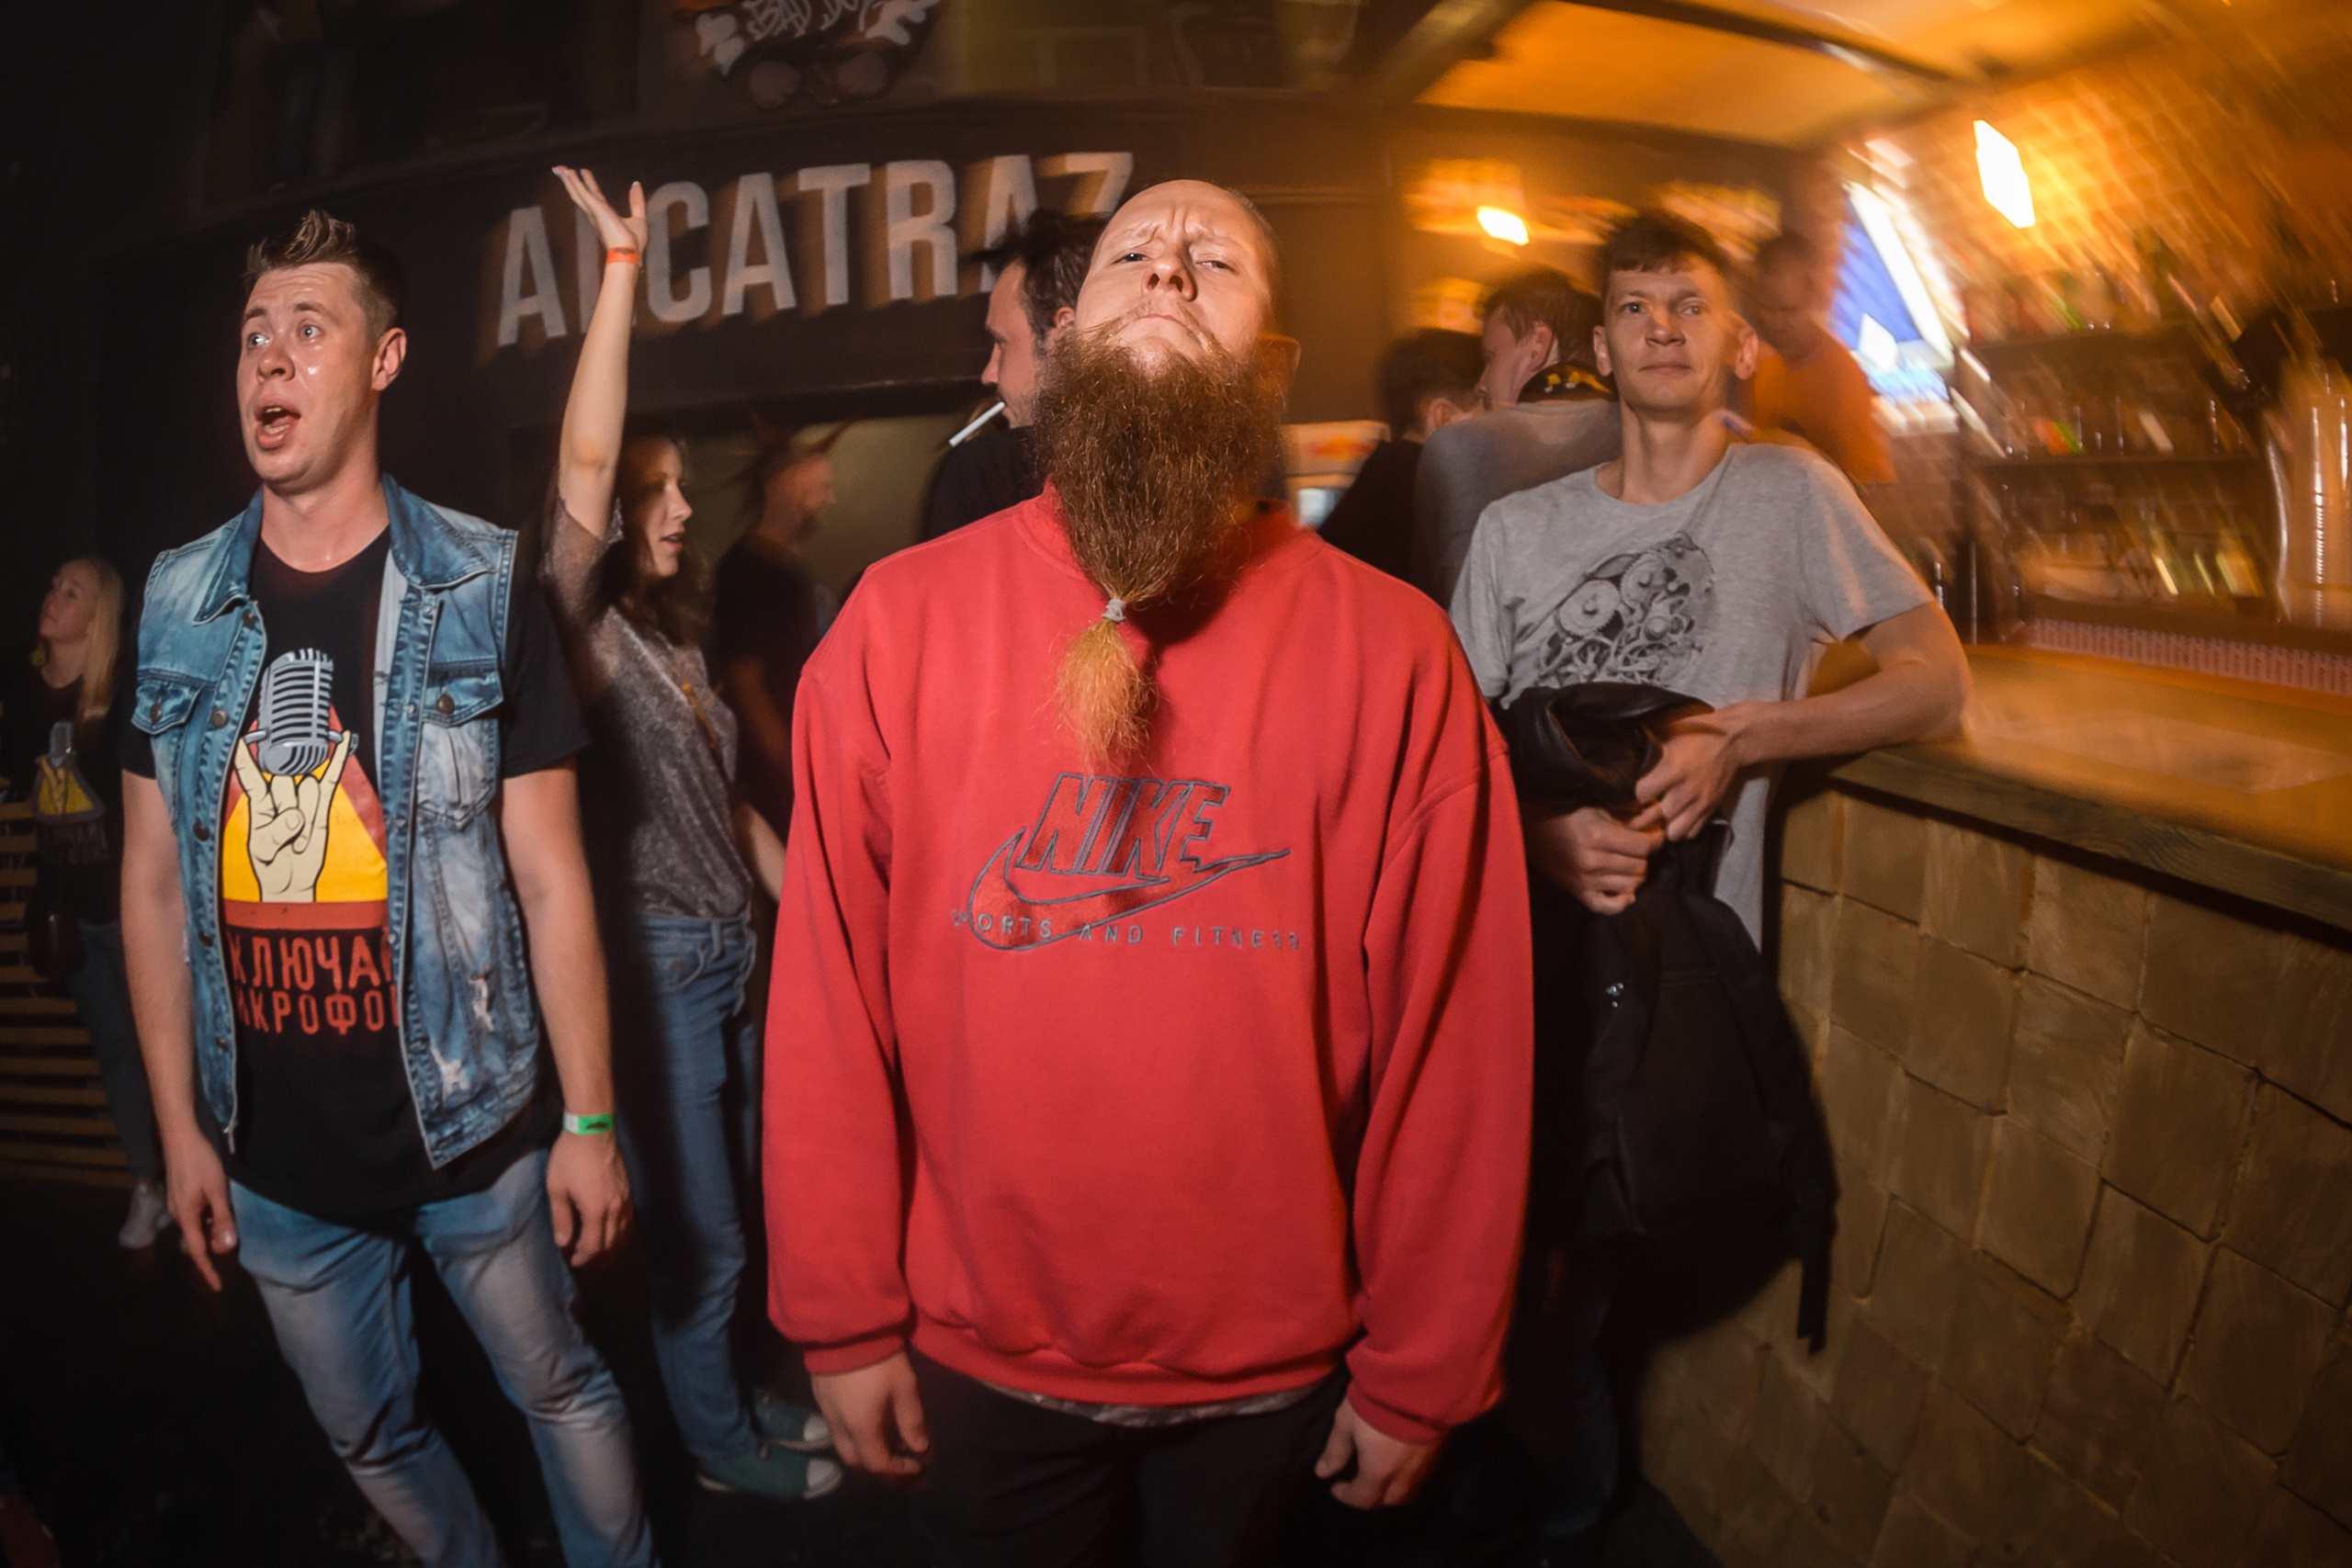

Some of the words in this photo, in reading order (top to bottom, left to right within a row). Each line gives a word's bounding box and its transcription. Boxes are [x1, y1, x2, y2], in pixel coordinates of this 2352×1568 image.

[1014, 772, 1231, 880] NIKE
[1078, 923, 1144, 944] AND
[1171, 926, 1299, 950] FITNESS
